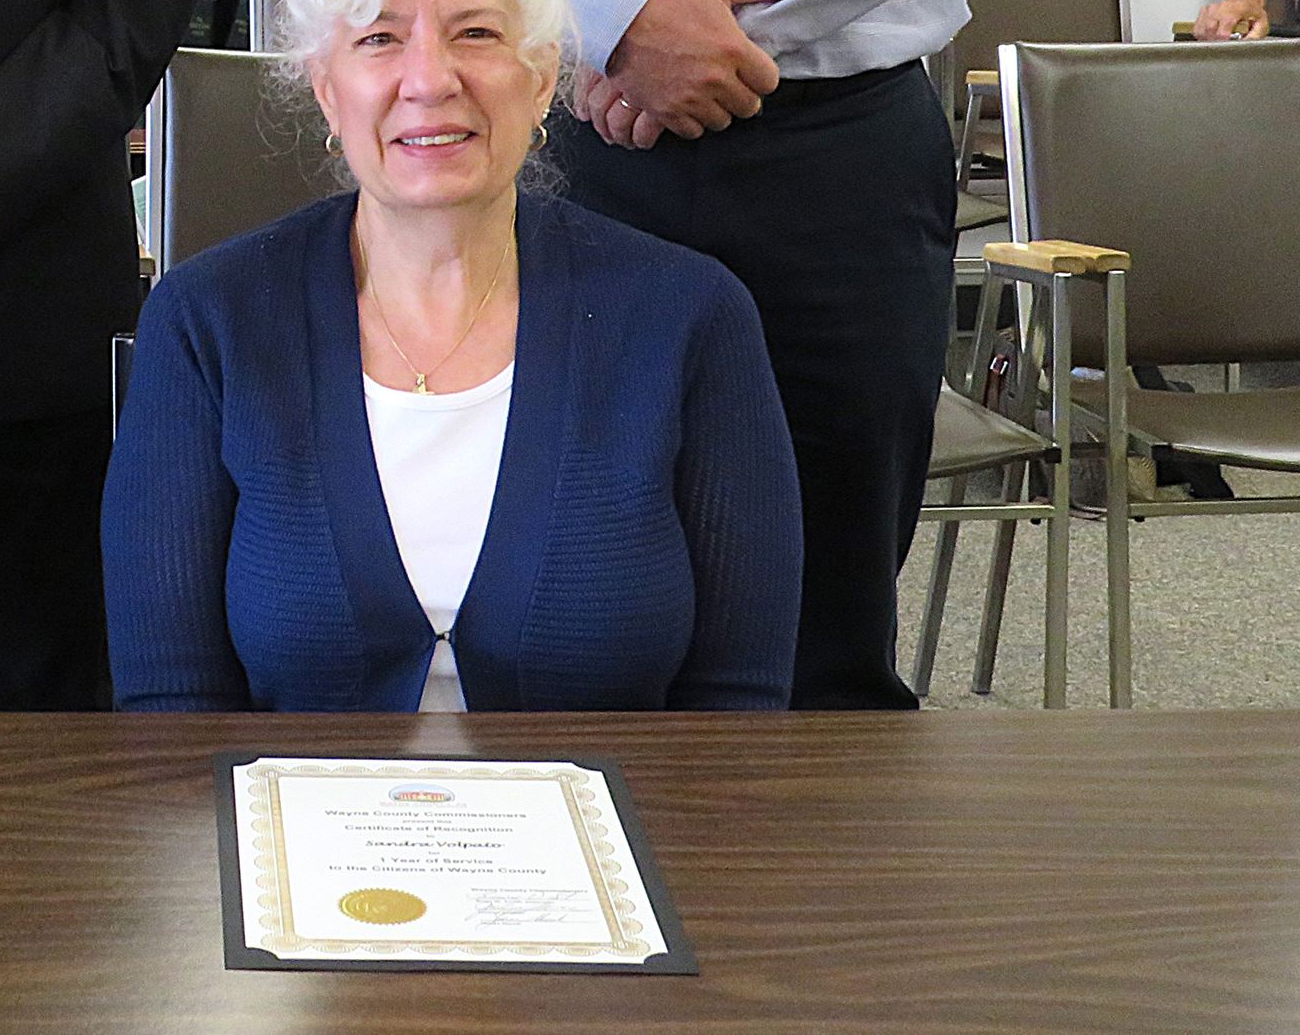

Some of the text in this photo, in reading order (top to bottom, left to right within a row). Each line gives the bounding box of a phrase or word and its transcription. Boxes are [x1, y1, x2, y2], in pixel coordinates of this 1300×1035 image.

[325, 809, 370, 817] Wayne
[373, 810, 420, 818] County
[344, 824, 413, 832] Certificate
[433, 825, 514, 834] Recognition
[365, 839, 434, 848] Sandra
[443, 857, 494, 865] Service
[371, 865, 426, 873] Citizens
[447, 866, 494, 874] Wayne
[498, 867, 548, 875] County
